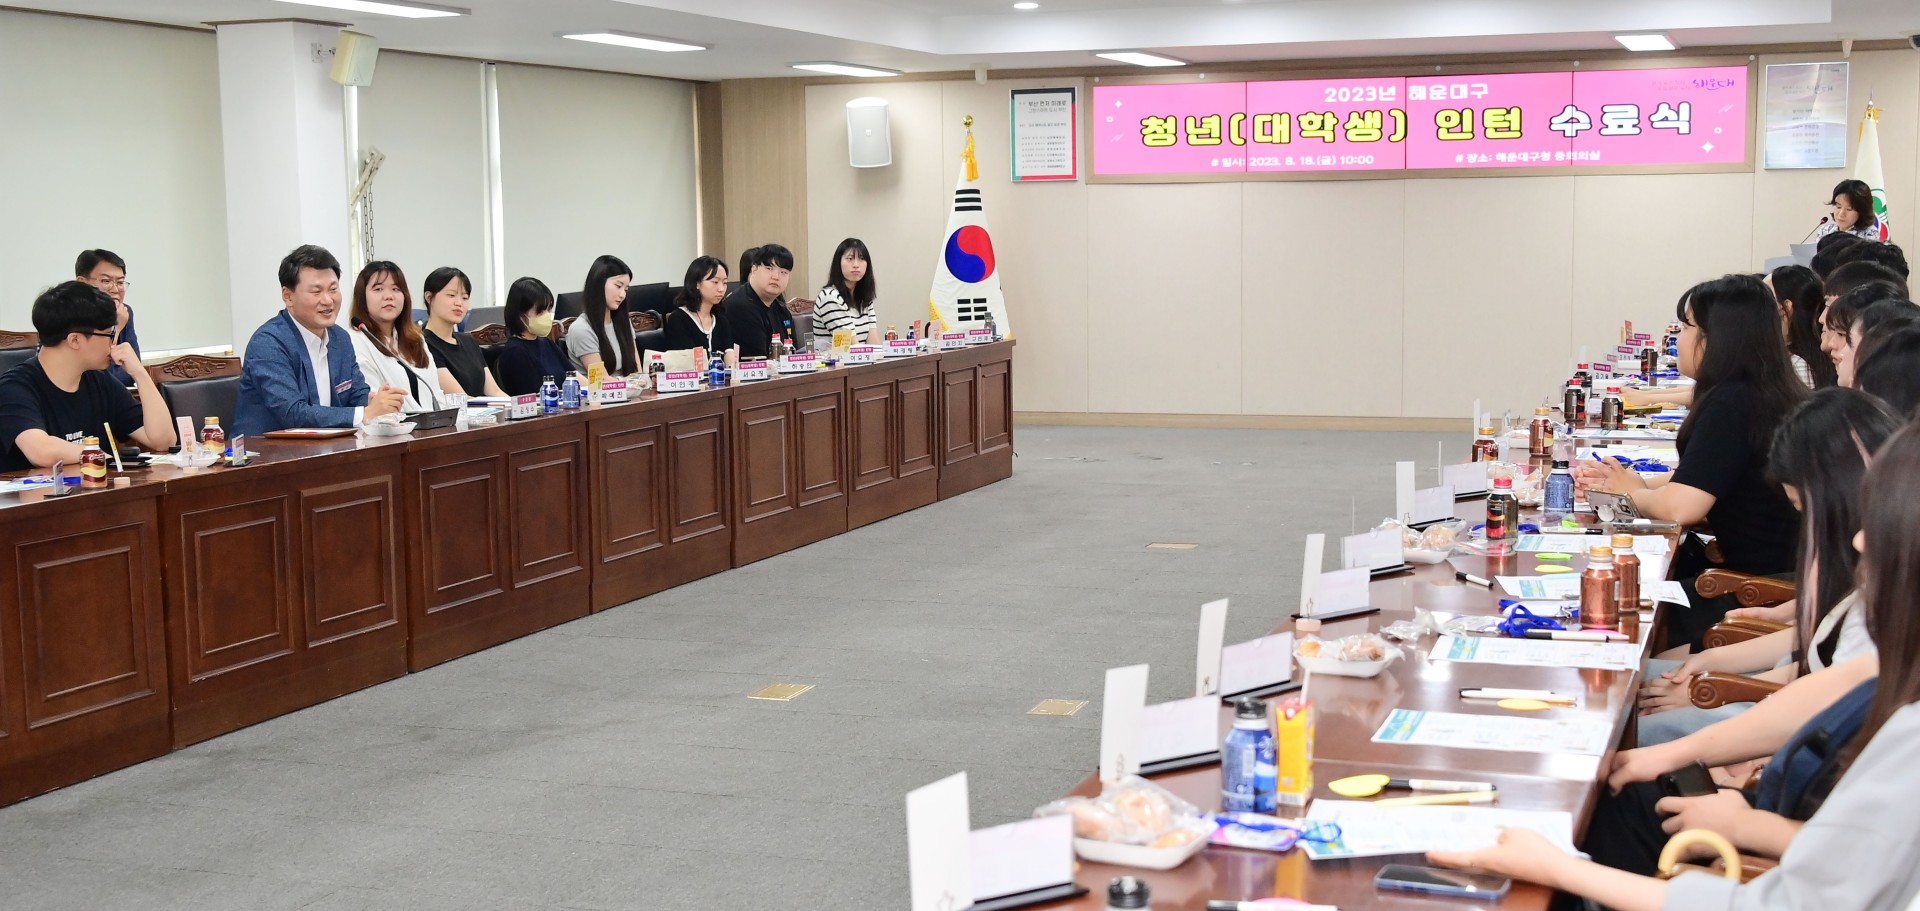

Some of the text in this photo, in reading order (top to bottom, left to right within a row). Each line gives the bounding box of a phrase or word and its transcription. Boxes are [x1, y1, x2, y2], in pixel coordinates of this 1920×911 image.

[1324, 83, 1489, 103] 2023년 해운대구
[1140, 101, 1691, 147] 청년(대학생) 인턴 수료식
[1222, 157, 1246, 168] 일시:
[1249, 156, 1281, 167] 2023.
[1285, 156, 1296, 166] 8.
[1299, 155, 1337, 166] 18.(금)
[1339, 155, 1375, 165] 10:00
[1466, 152, 1492, 163] 장소:
[1495, 151, 1551, 163] 해운대구청
